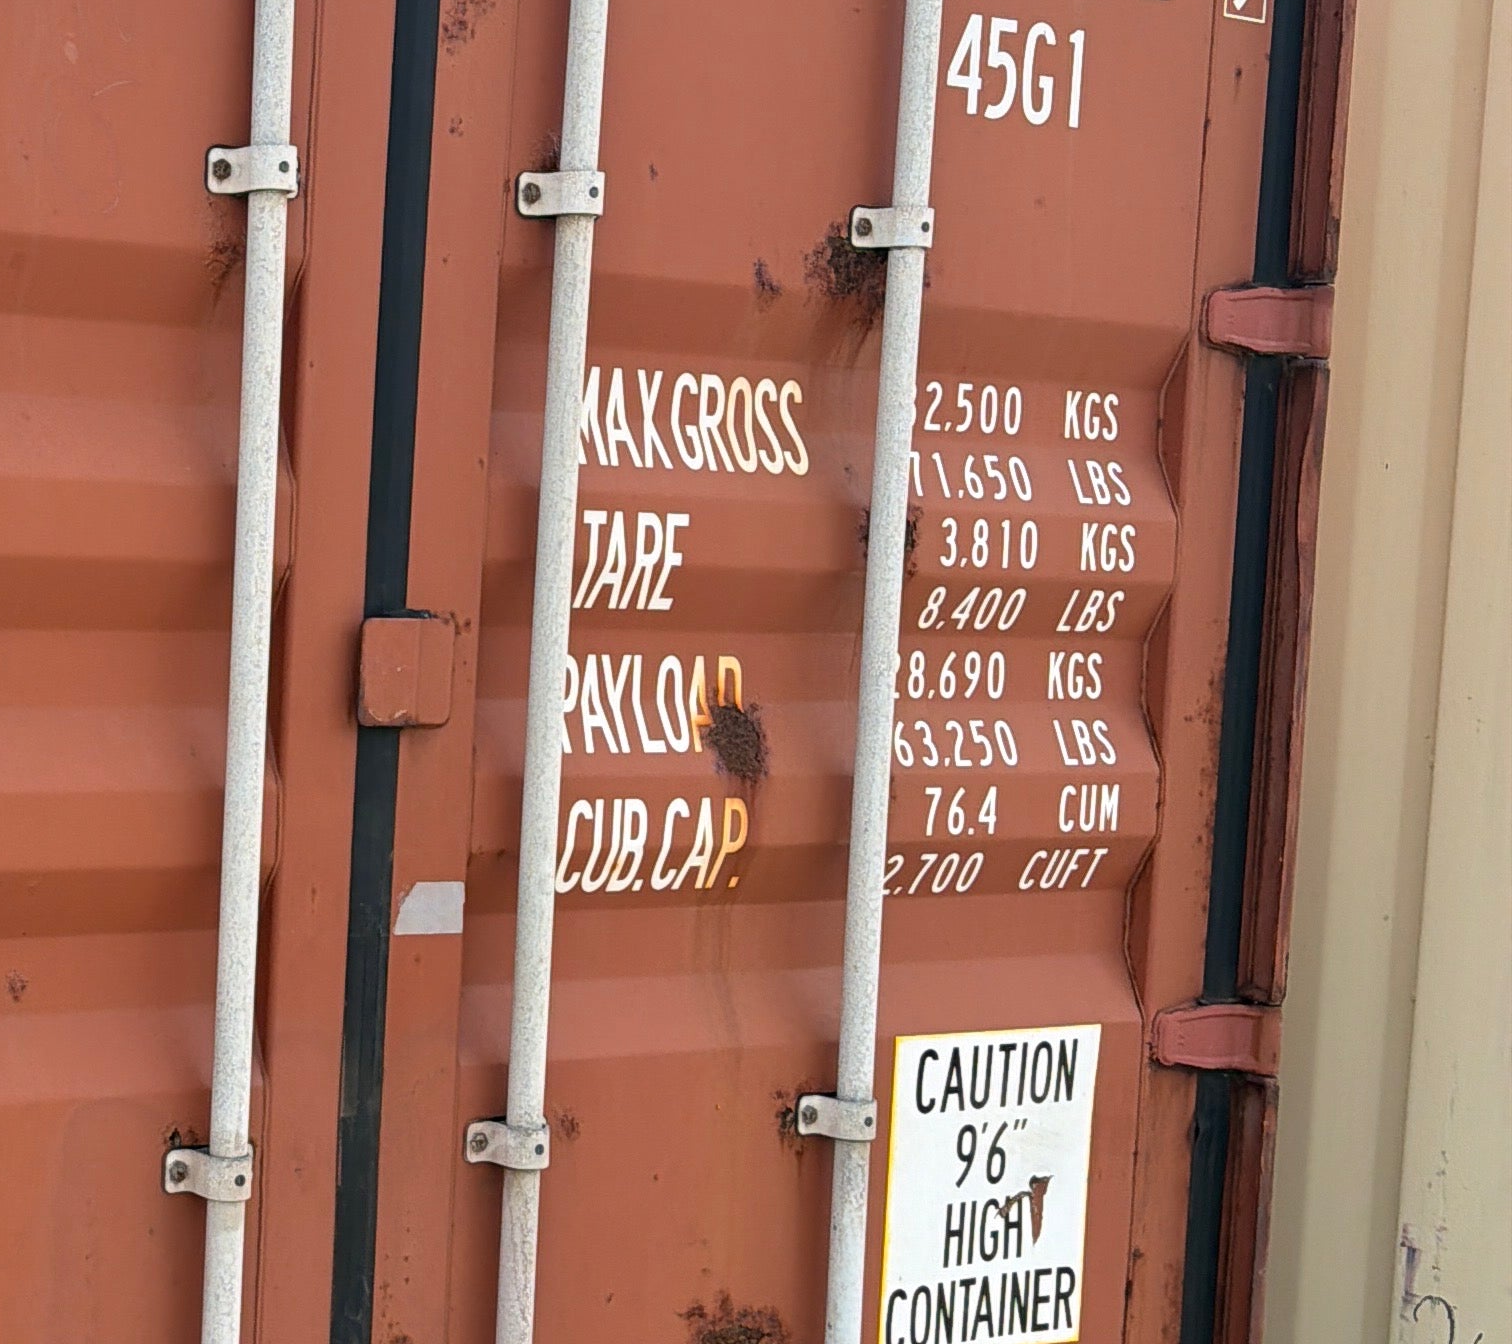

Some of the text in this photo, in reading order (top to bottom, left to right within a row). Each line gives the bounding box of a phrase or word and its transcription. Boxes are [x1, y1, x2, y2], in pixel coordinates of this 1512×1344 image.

[946, 14, 1086, 129] 45G1
[669, 373, 810, 476] GROSS
[909, 380, 1119, 442] 2,500 KGS
[1067, 459, 1131, 506] LBS
[572, 510, 690, 611] TARE
[940, 517, 1136, 573] 3,810 KGS
[918, 587, 1125, 633] 8,400 LBS
[1048, 652, 1103, 701] KGS
[893, 719, 1117, 768] 63,250 LBS
[924, 784, 1120, 837] 76.4 CUM
[1018, 848, 1110, 891] CUFT
[915, 1038, 1079, 1114] CAUTION
[943, 1196, 1023, 1268] HIGH
